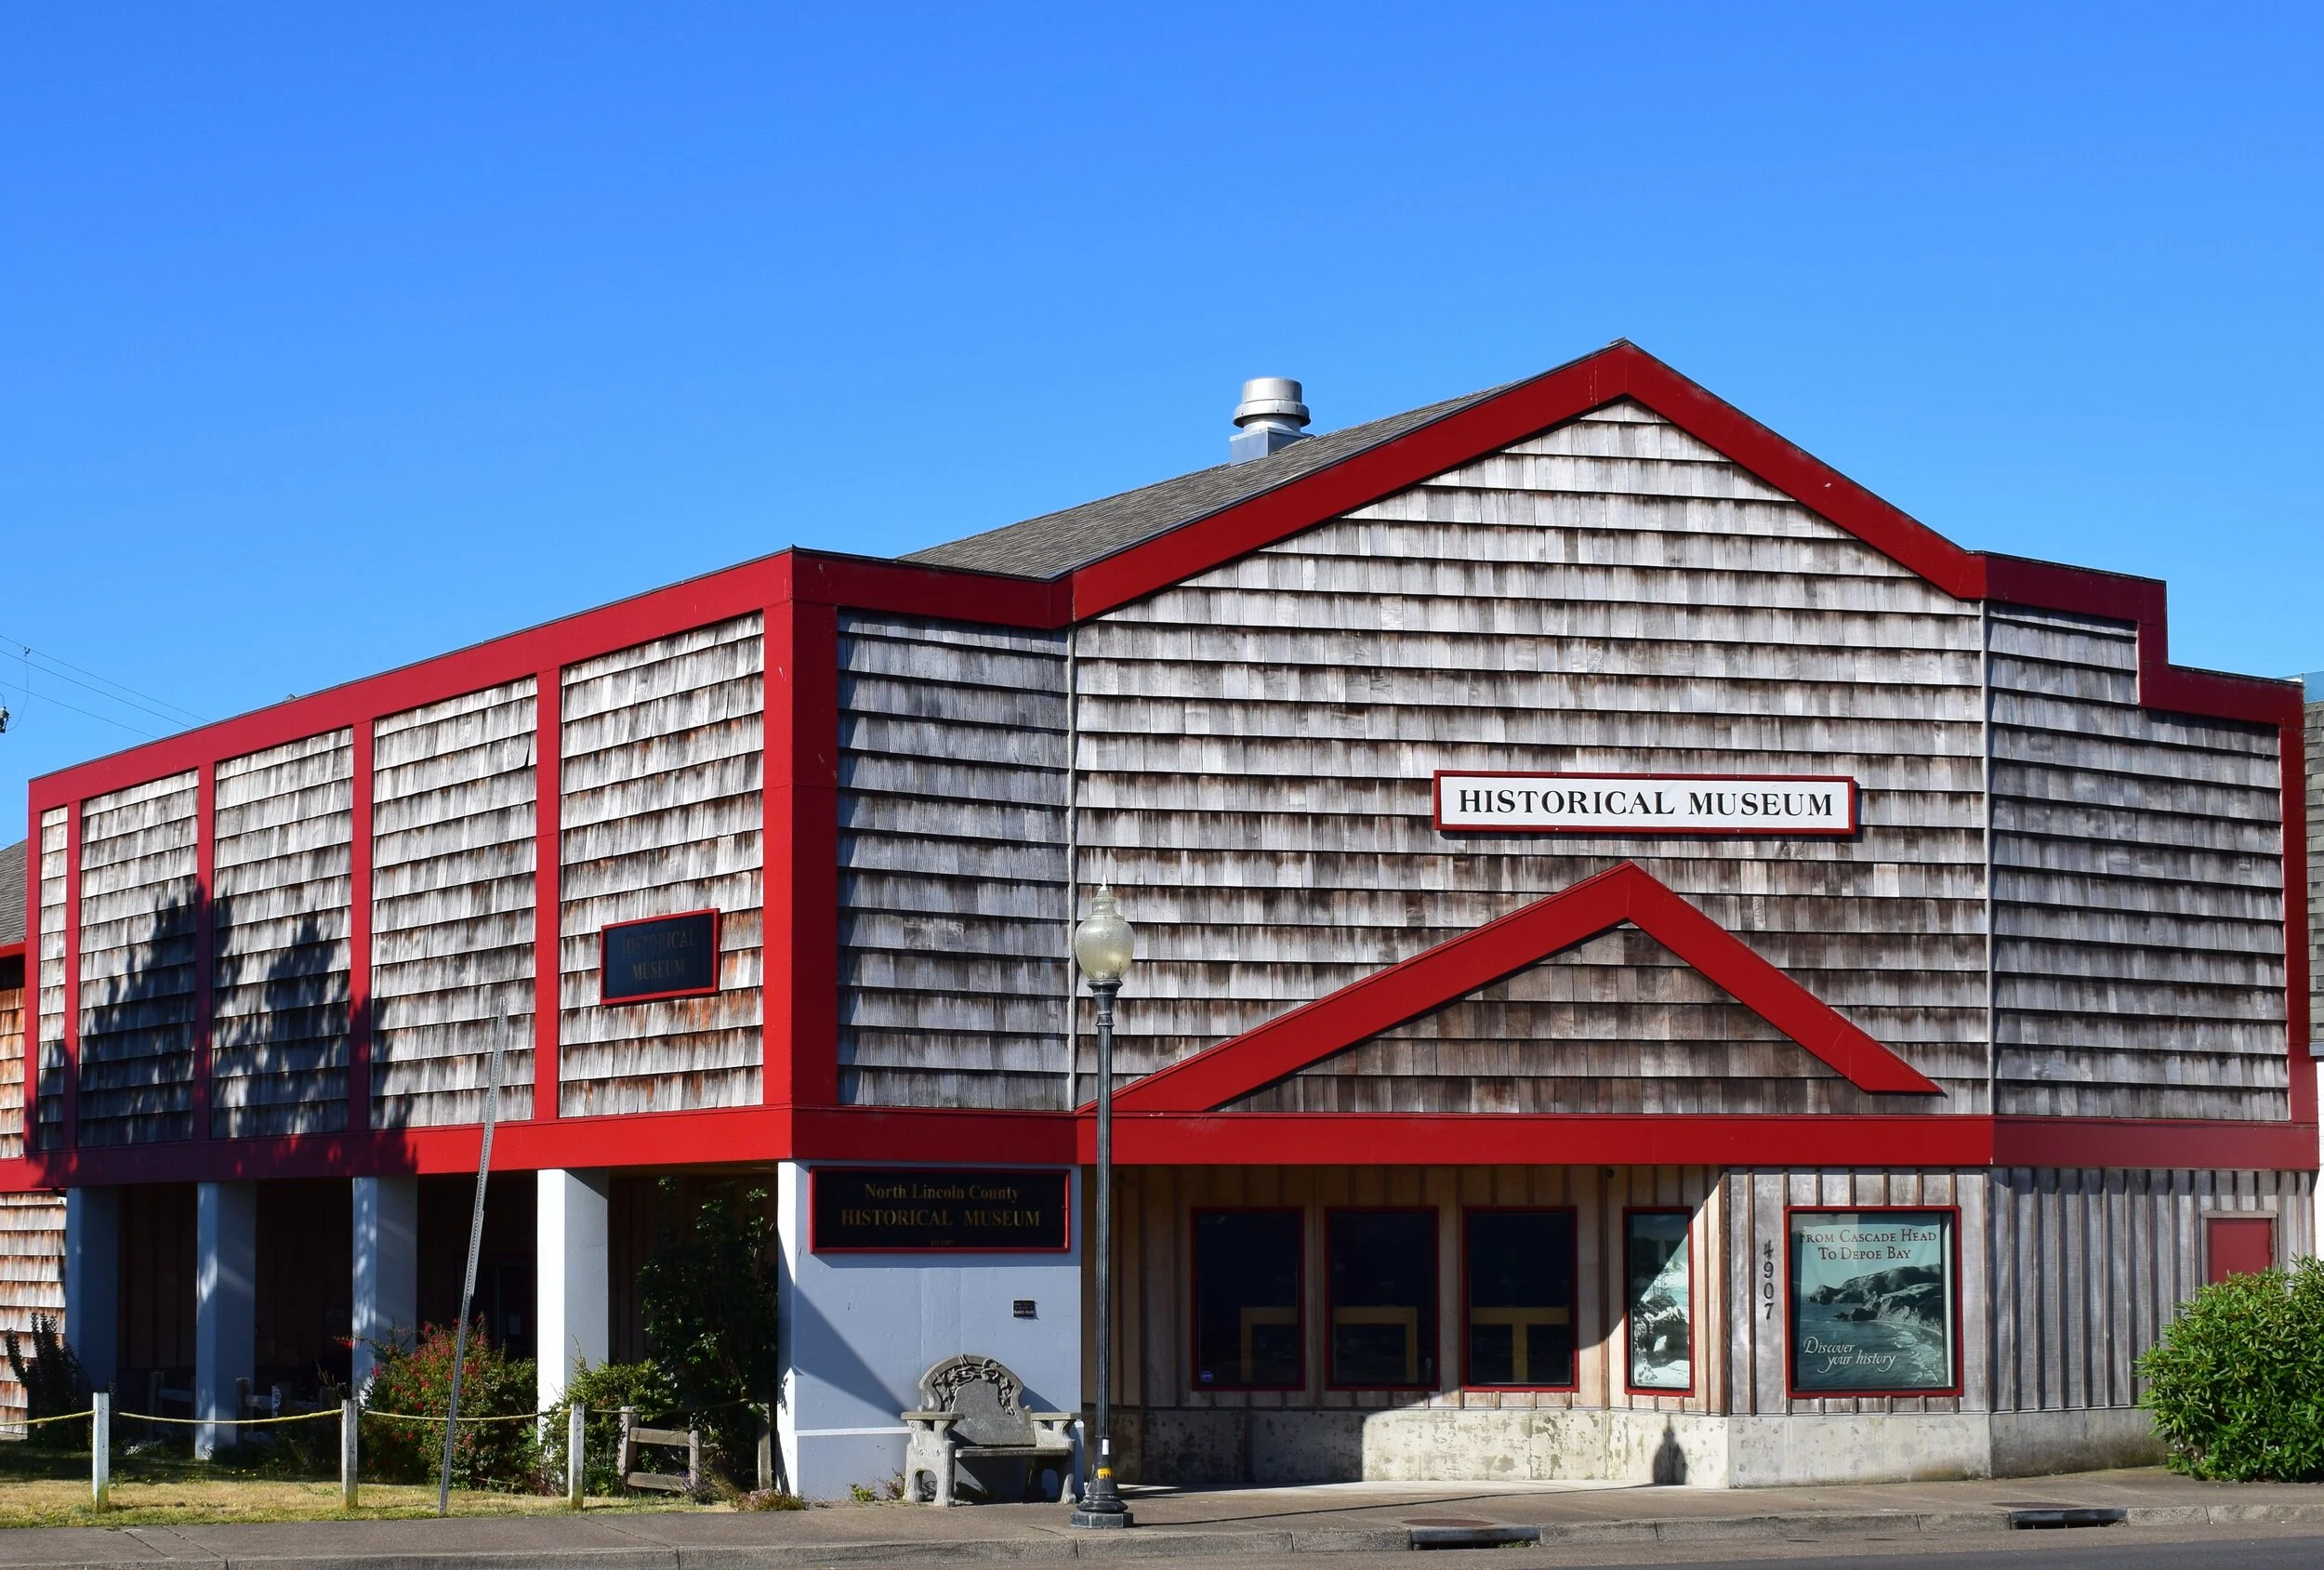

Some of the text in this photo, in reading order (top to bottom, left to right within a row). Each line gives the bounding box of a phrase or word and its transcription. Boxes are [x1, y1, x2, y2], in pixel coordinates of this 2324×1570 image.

[1459, 789, 1832, 816] HISTORICAL MUSEUM
[632, 958, 685, 981] MUSEUM
[865, 1183, 1019, 1203] North Lincoln County
[841, 1209, 1040, 1227] HISTORICAL MUSEUM
[1840, 1229, 1896, 1243] CASCADE
[1901, 1229, 1936, 1243] HEAD
[1841, 1247, 1882, 1260] DEPOE
[1886, 1247, 1912, 1260] BAY
[1763, 1240, 1775, 1320] 4907
[1803, 1337, 1855, 1353] Discover
[1816, 1350, 1896, 1374] your history
